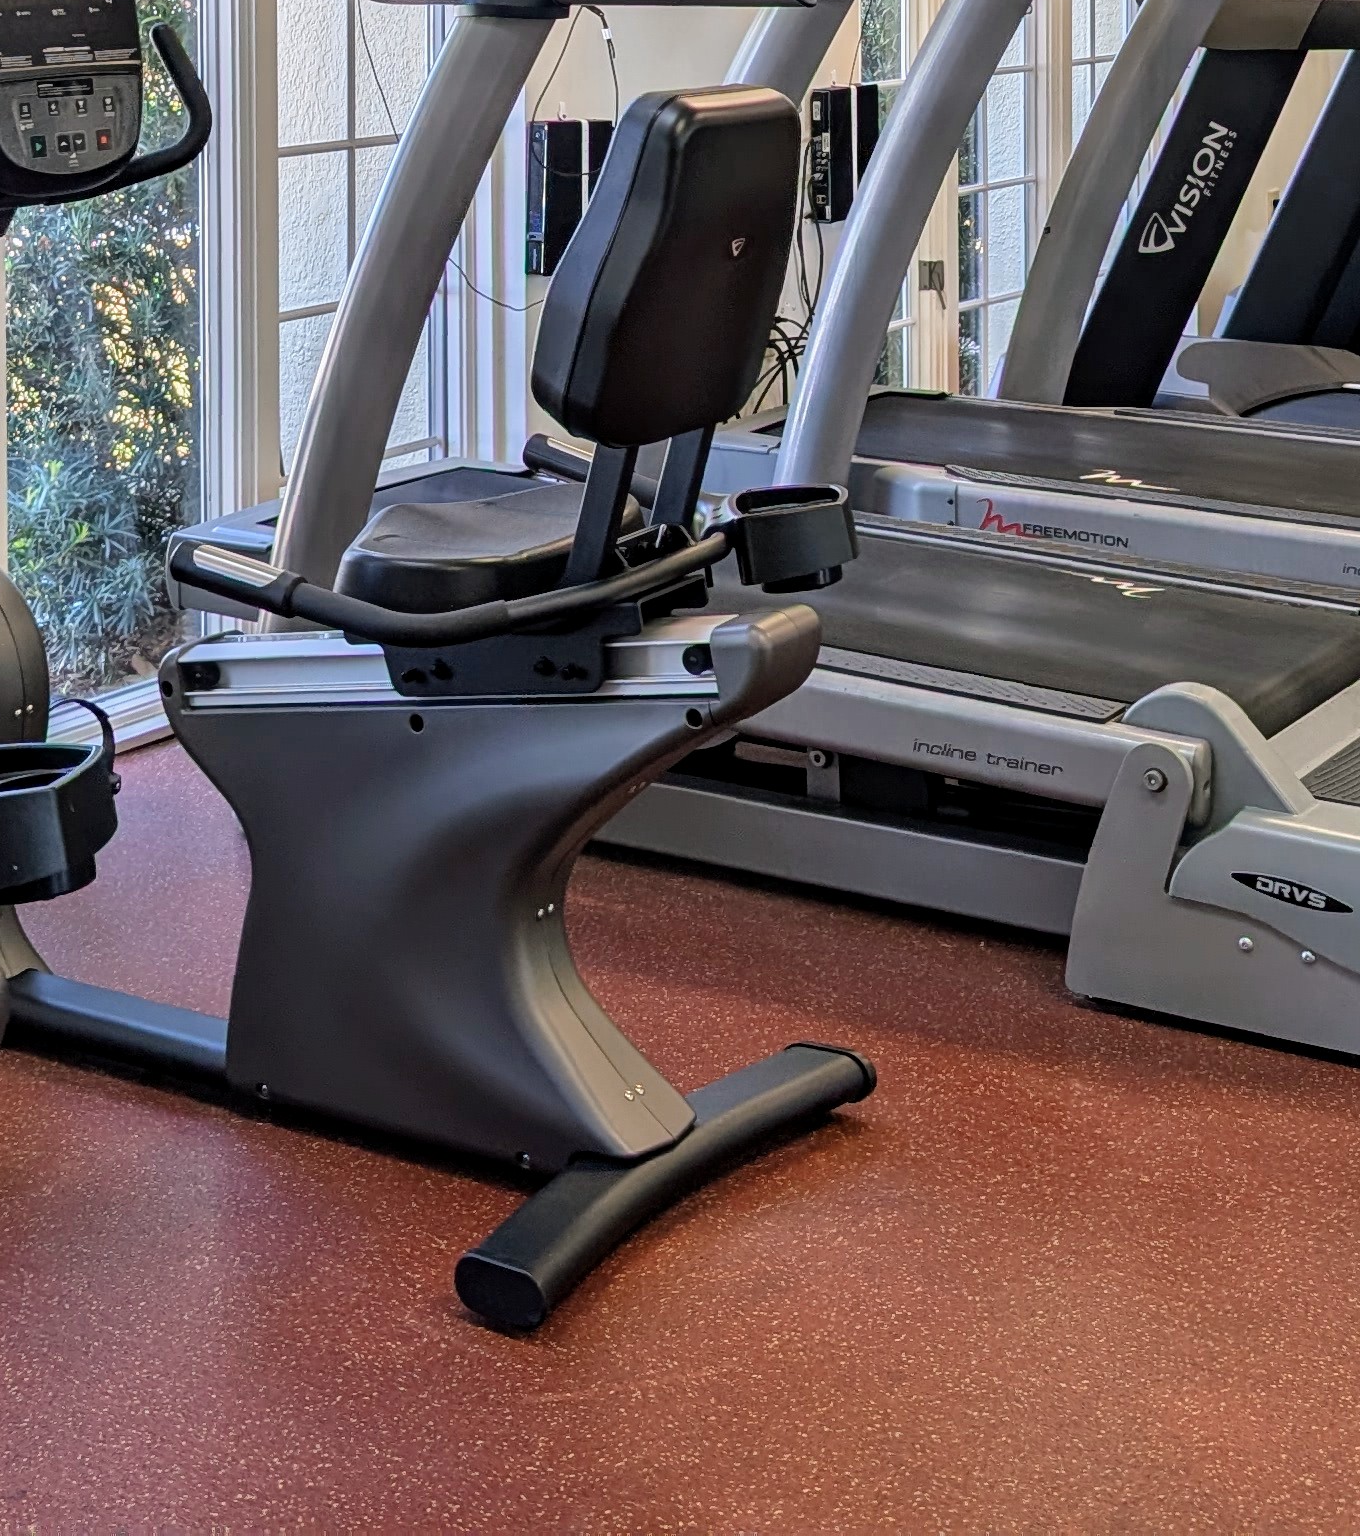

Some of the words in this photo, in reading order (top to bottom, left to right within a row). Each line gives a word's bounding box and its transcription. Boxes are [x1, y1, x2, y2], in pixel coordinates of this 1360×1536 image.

[1168, 120, 1229, 233] VISION
[1202, 130, 1238, 197] FITNESS
[1022, 523, 1129, 549] FREEMOTION
[912, 738, 977, 762] incline
[985, 752, 1064, 776] trainer
[1256, 876, 1327, 910] DRVS
